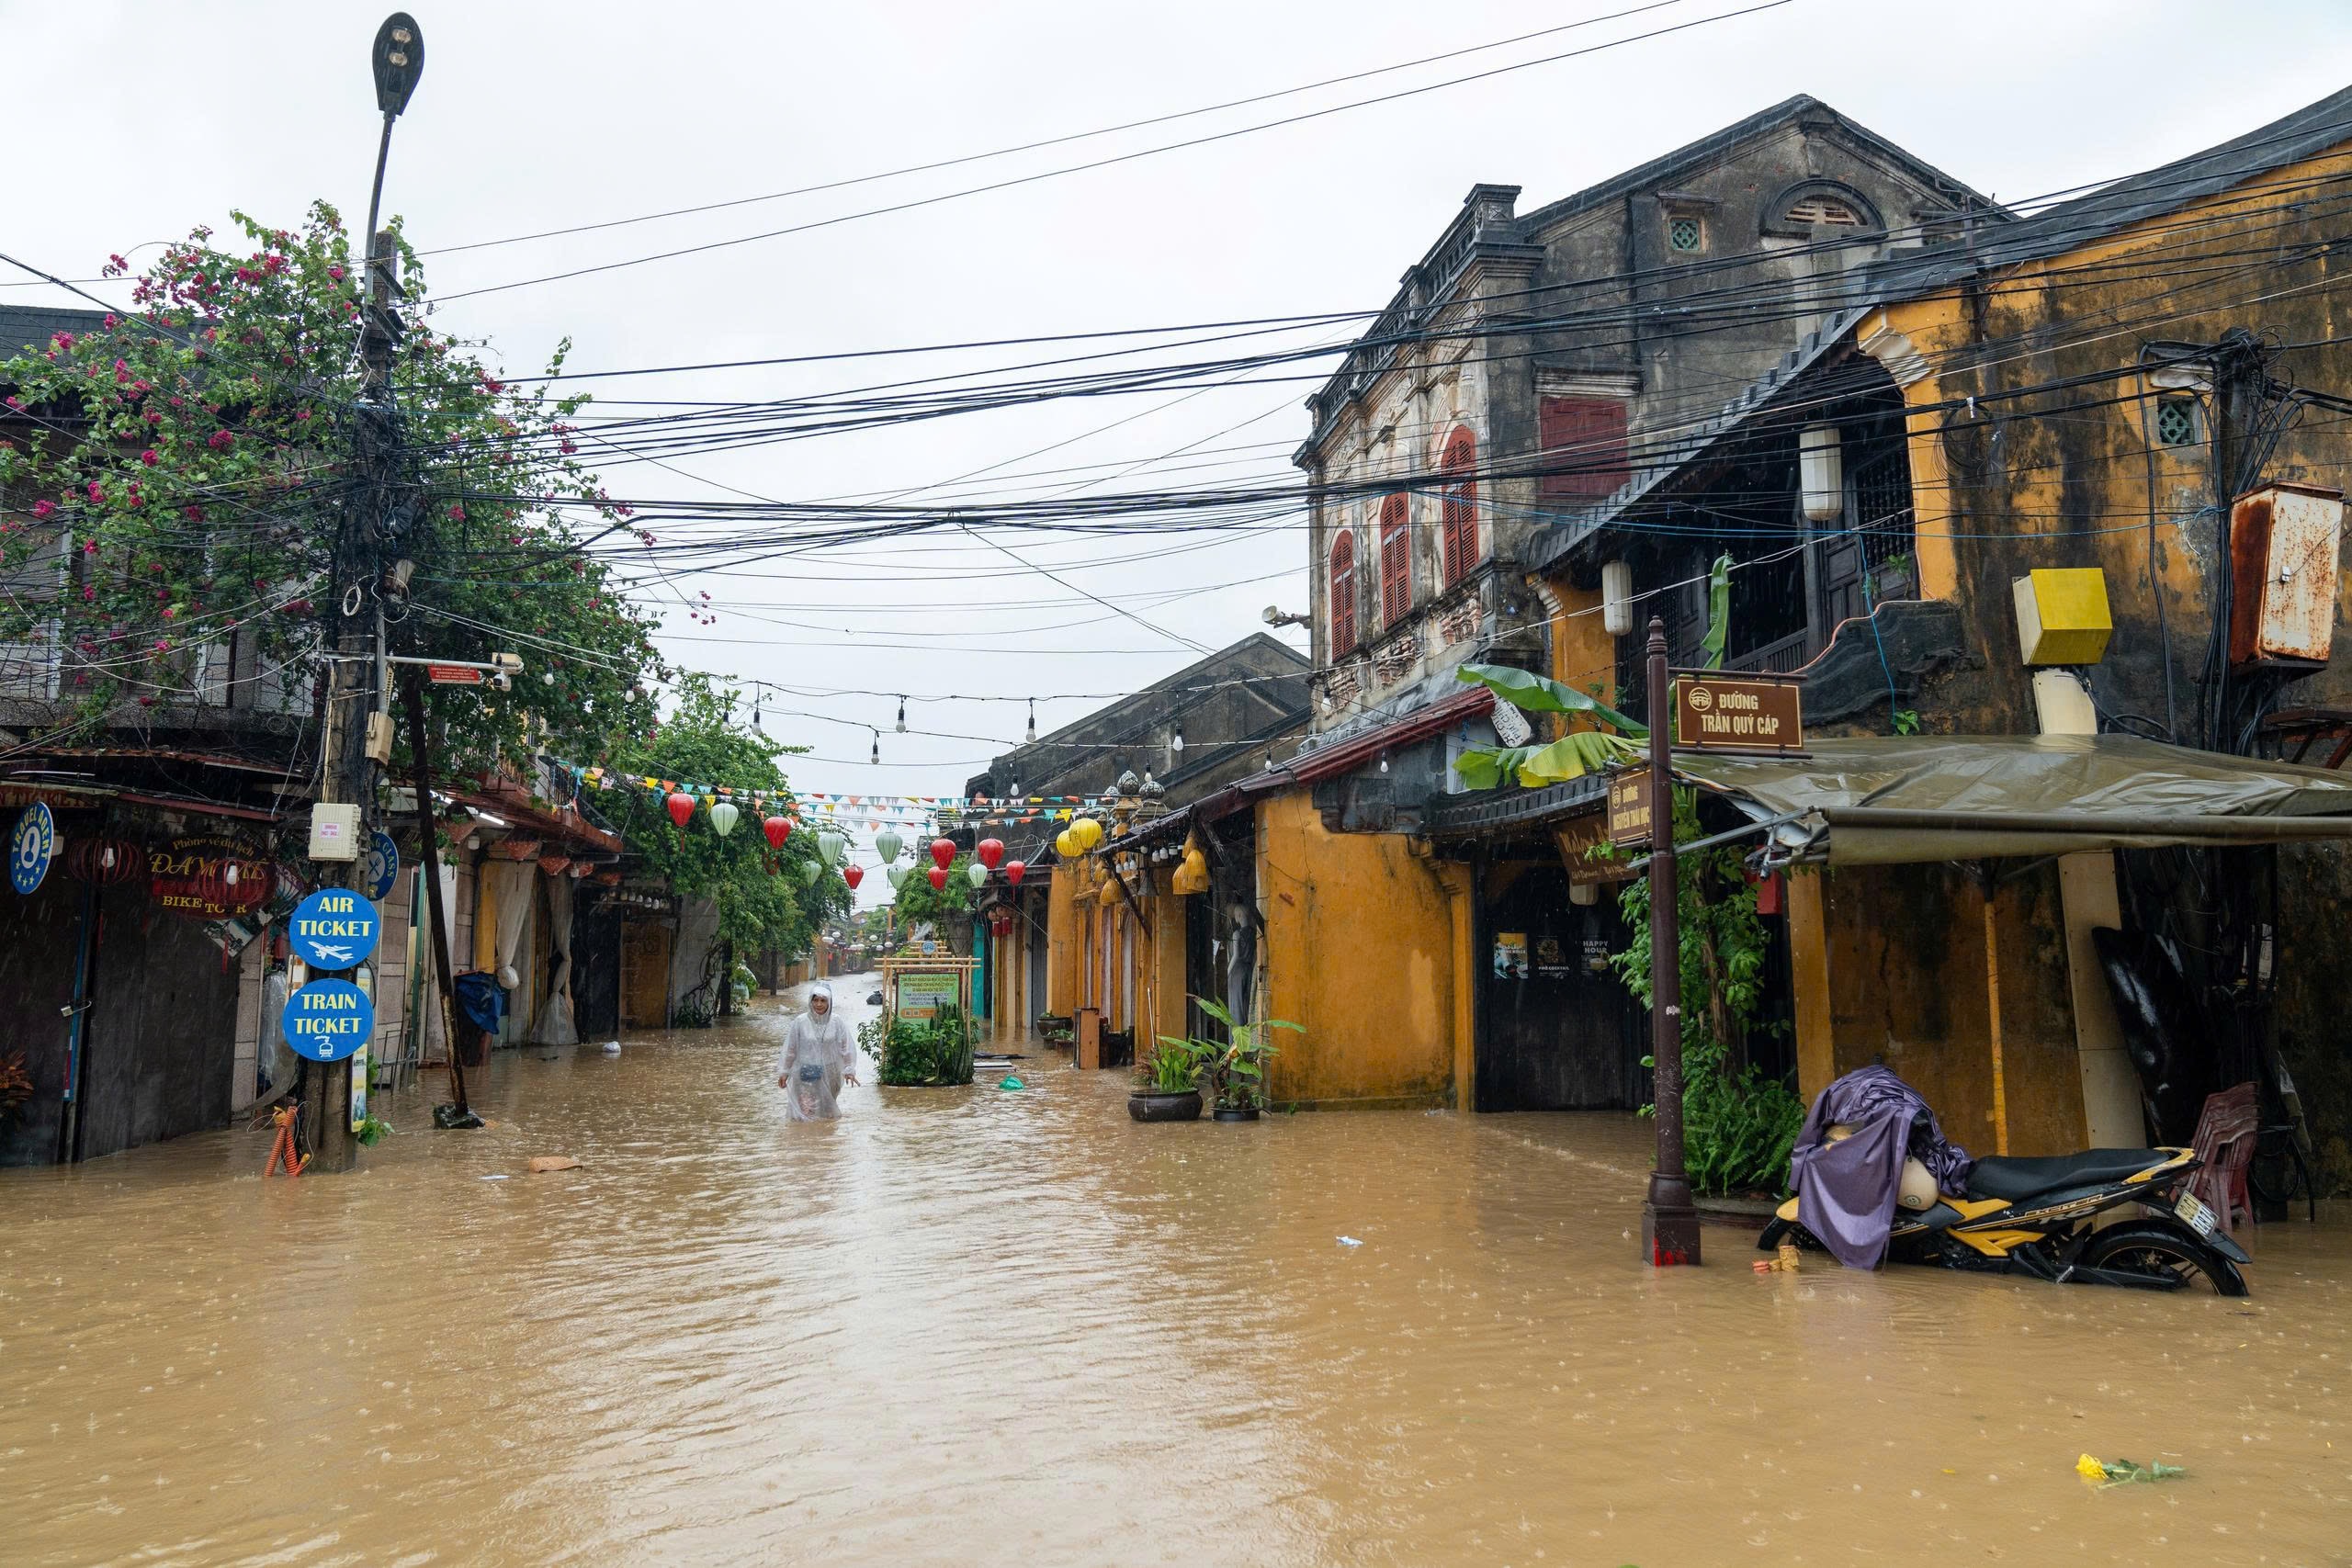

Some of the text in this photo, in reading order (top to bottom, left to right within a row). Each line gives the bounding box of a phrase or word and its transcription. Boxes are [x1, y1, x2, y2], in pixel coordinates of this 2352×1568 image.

[1719, 691, 1758, 710] ĐƯỜNG
[1701, 708, 1779, 735] TRẦN QUÝ CÁP
[163, 896, 247, 914] BIKE TOR
[318, 897, 354, 913] AIR
[297, 919, 373, 937] TICKET
[300, 993, 356, 1010] TRAIN
[294, 1017, 362, 1034] TICKET
